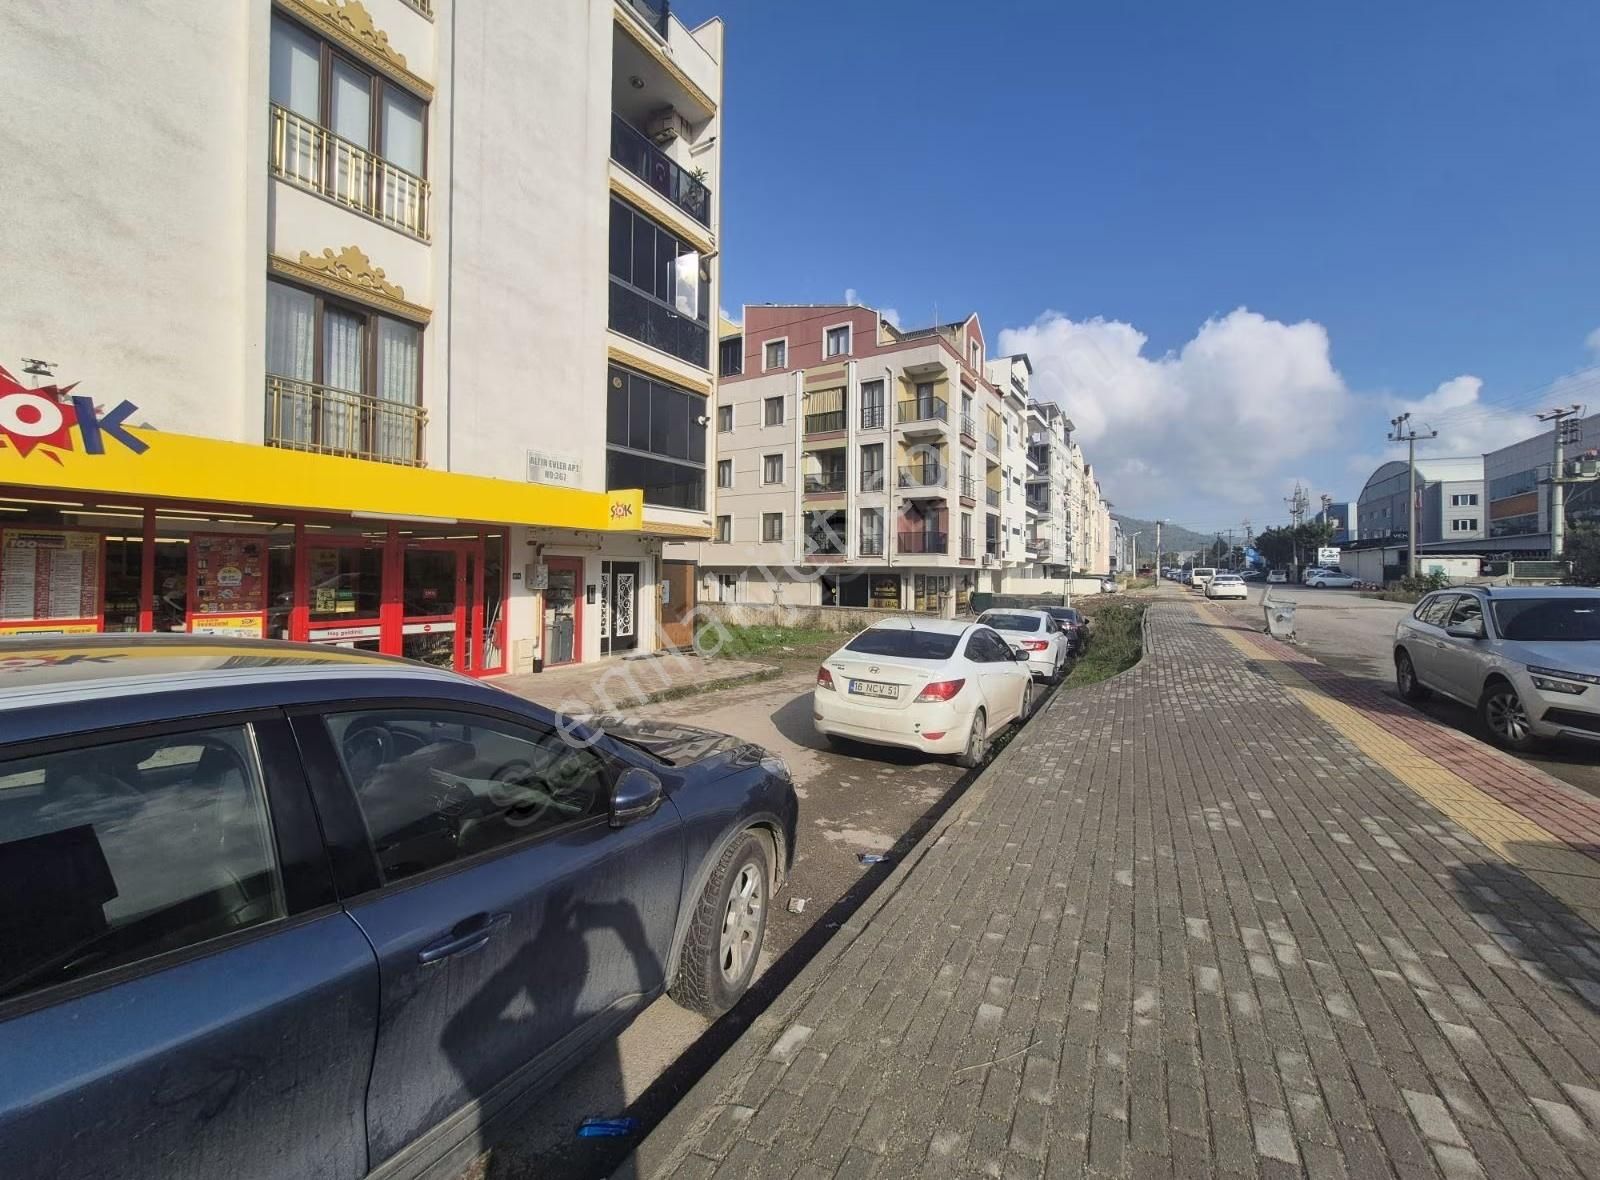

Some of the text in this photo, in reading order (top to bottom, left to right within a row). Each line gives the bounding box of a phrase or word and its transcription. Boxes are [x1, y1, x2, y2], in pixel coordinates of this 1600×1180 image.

[549, 459, 567, 471] EVLER
[610, 502, 633, 521] ŞOK
[853, 681, 898, 695] 16 NCV 51
